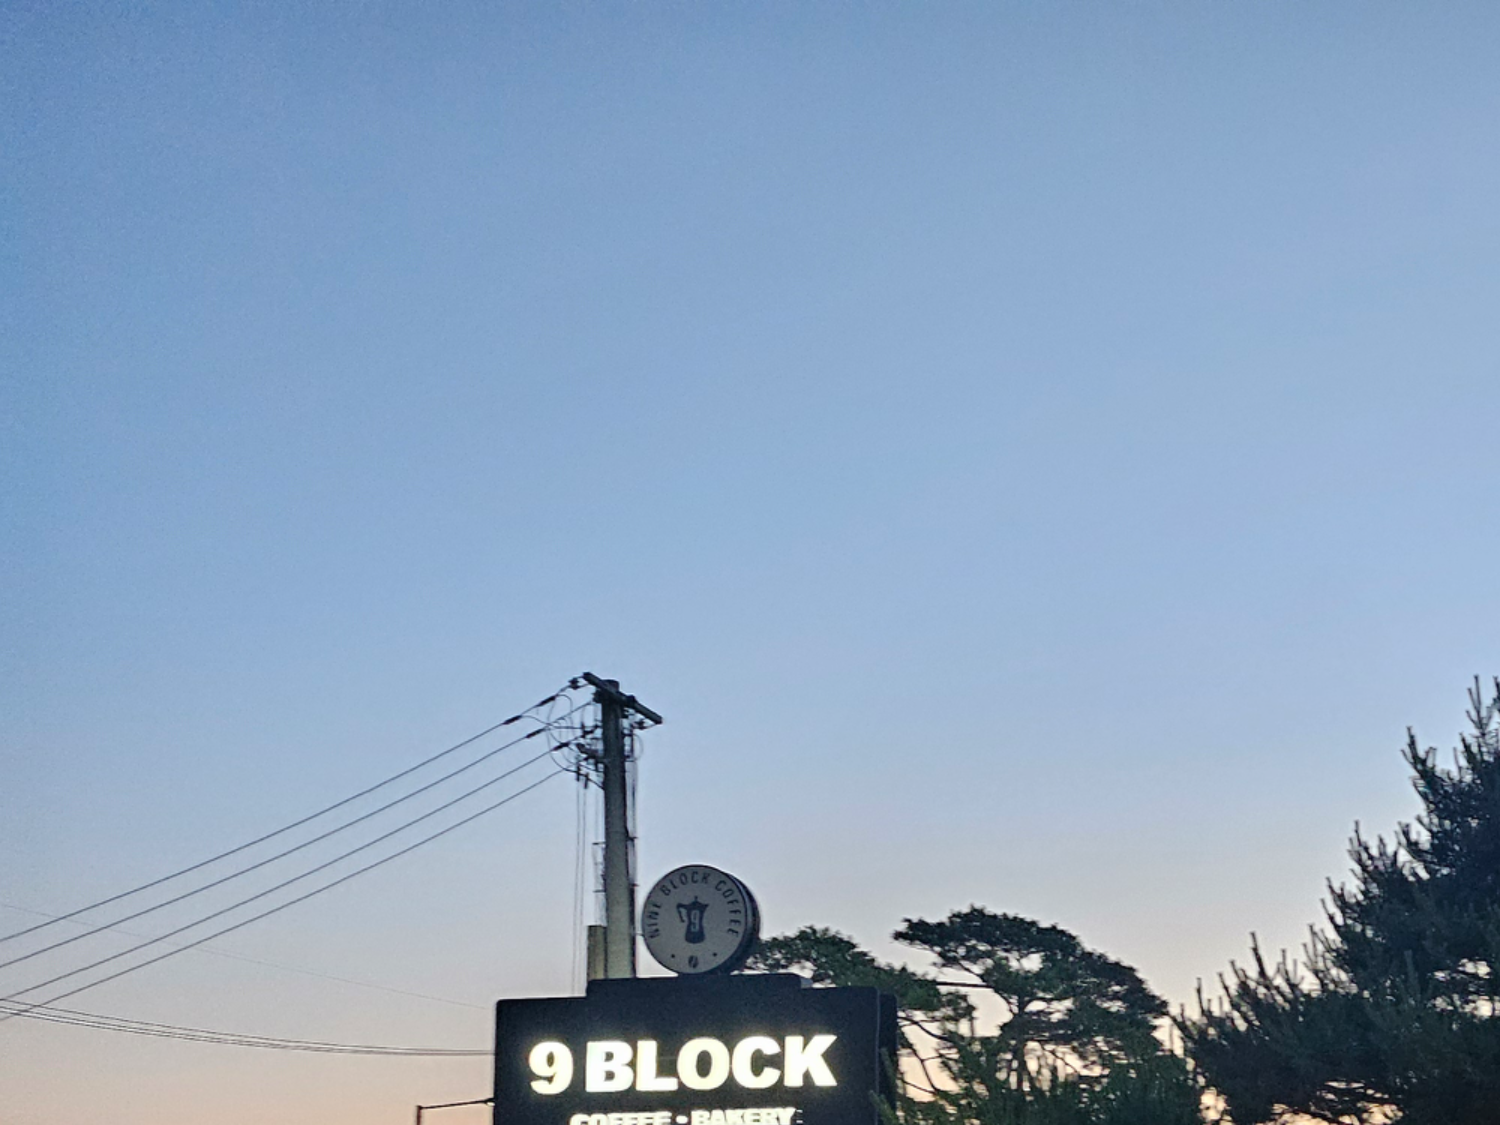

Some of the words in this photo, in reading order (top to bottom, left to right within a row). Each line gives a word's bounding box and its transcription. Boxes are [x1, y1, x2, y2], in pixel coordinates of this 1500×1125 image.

[646, 903, 661, 939] NINE
[660, 871, 711, 896] BLOCK
[715, 879, 742, 937] COFFEE
[529, 1041, 574, 1095] 9
[585, 1034, 838, 1093] BLOCK
